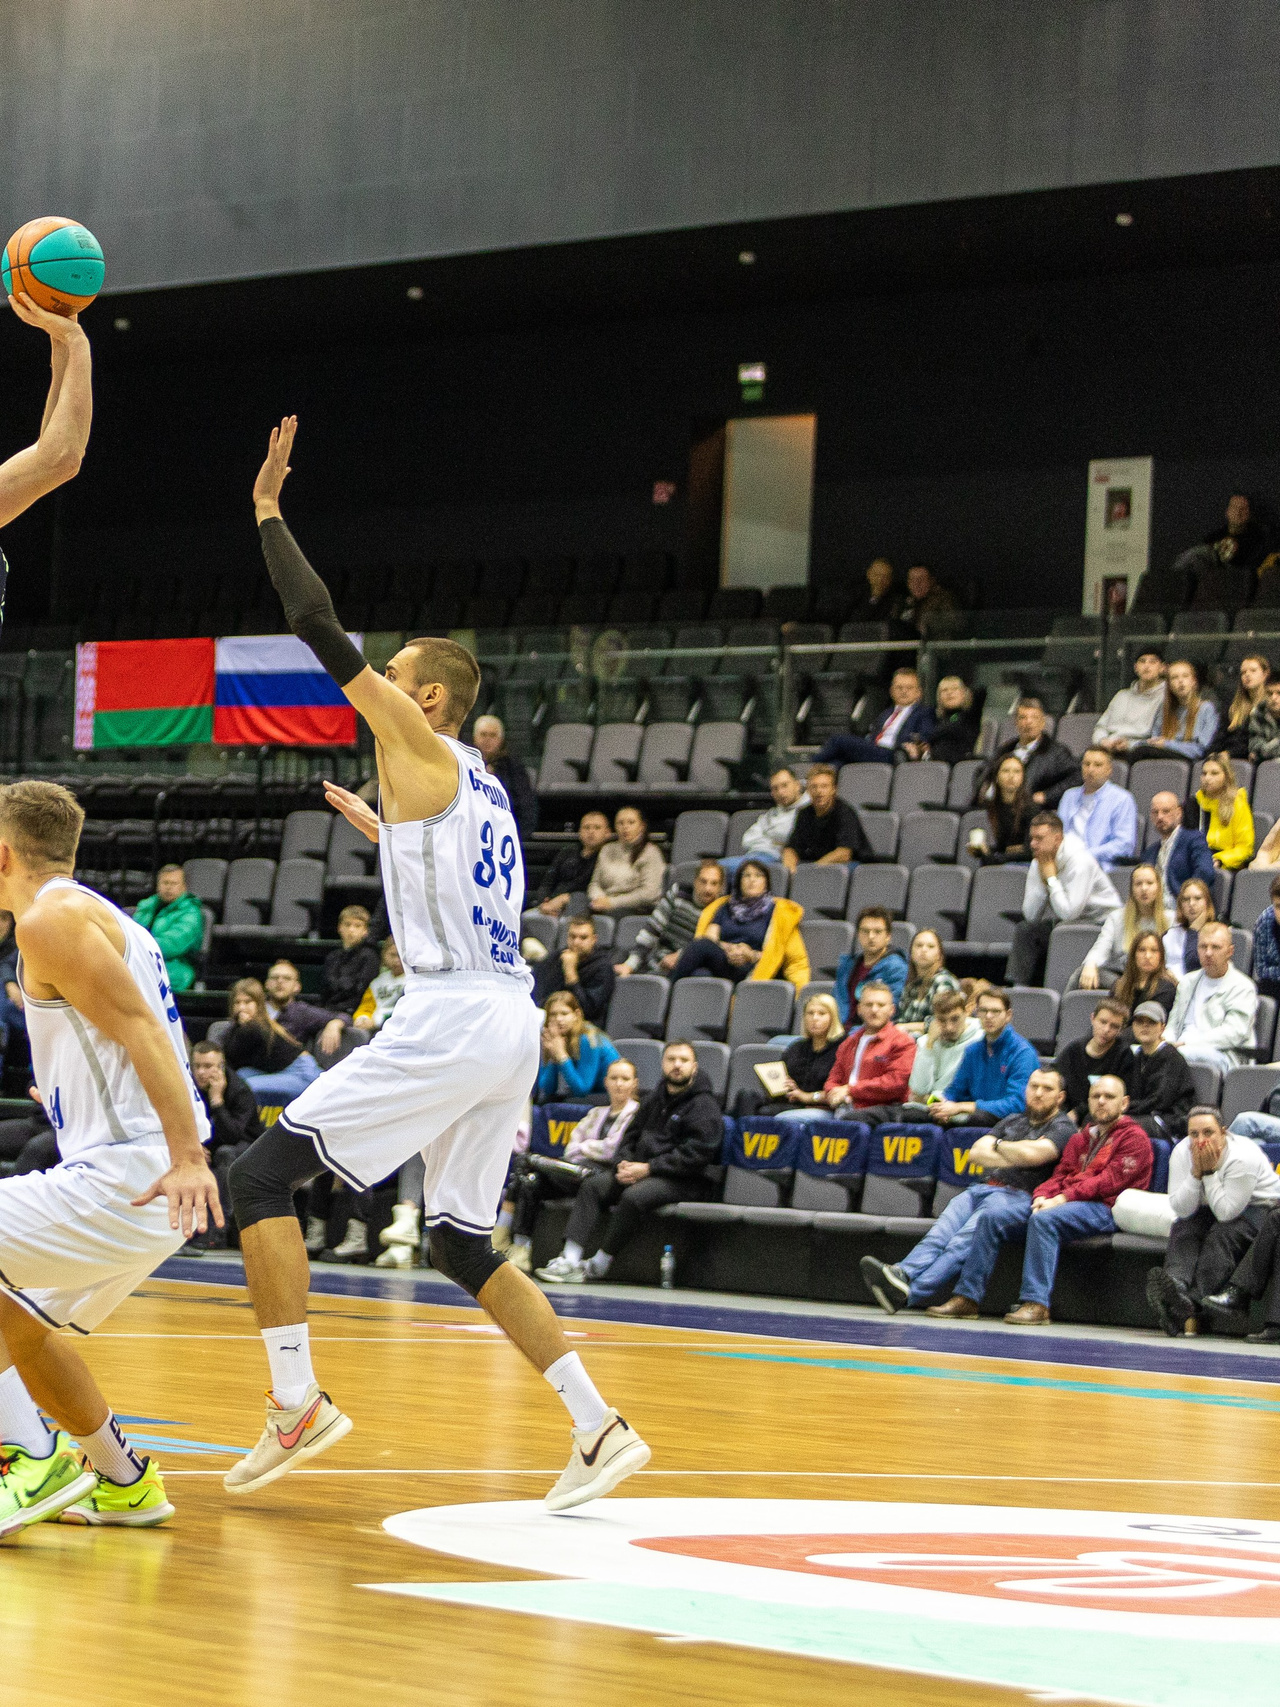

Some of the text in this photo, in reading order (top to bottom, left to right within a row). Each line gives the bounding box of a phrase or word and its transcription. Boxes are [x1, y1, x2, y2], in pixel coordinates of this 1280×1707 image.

[742, 1131, 780, 1160] VIP
[812, 1135, 850, 1165] VIP
[882, 1135, 923, 1165] VIP
